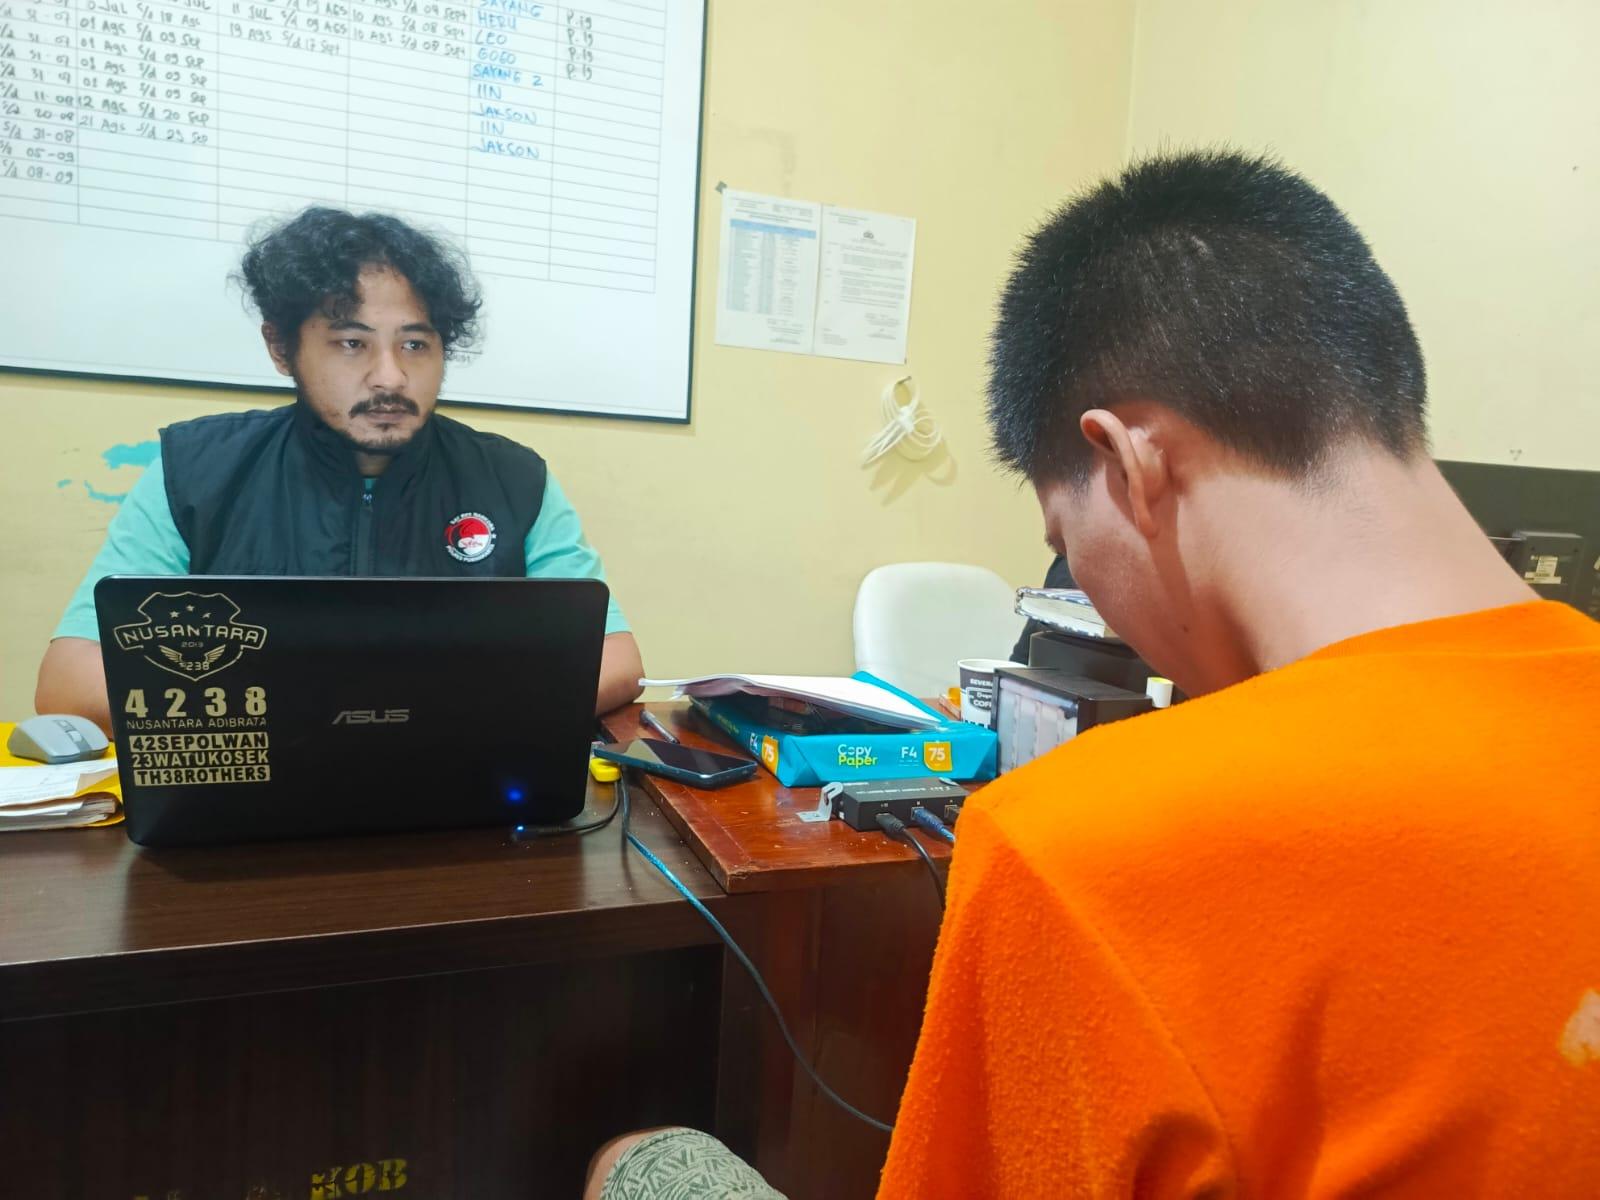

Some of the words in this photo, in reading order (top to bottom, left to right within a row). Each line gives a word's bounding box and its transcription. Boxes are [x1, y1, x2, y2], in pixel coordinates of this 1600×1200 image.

[475, 30, 507, 45] LEO
[472, 64, 521, 84] SAYANG
[472, 102, 537, 125] JAKSON
[471, 137, 540, 160] JAKSON
[122, 624, 260, 645] NUSANTARA
[126, 718, 203, 730] NUSANTARA
[208, 716, 267, 729] ADIBRATA
[332, 709, 410, 725] ASUS
[131, 732, 268, 752] 42SEPOLWAN
[132, 750, 269, 768] 23WATUKOSEK
[838, 744, 872, 759] Copy
[901, 746, 918, 759] F4
[928, 747, 946, 761] 75
[838, 755, 878, 768] Paper
[136, 766, 268, 786] TH38ROTHERS
